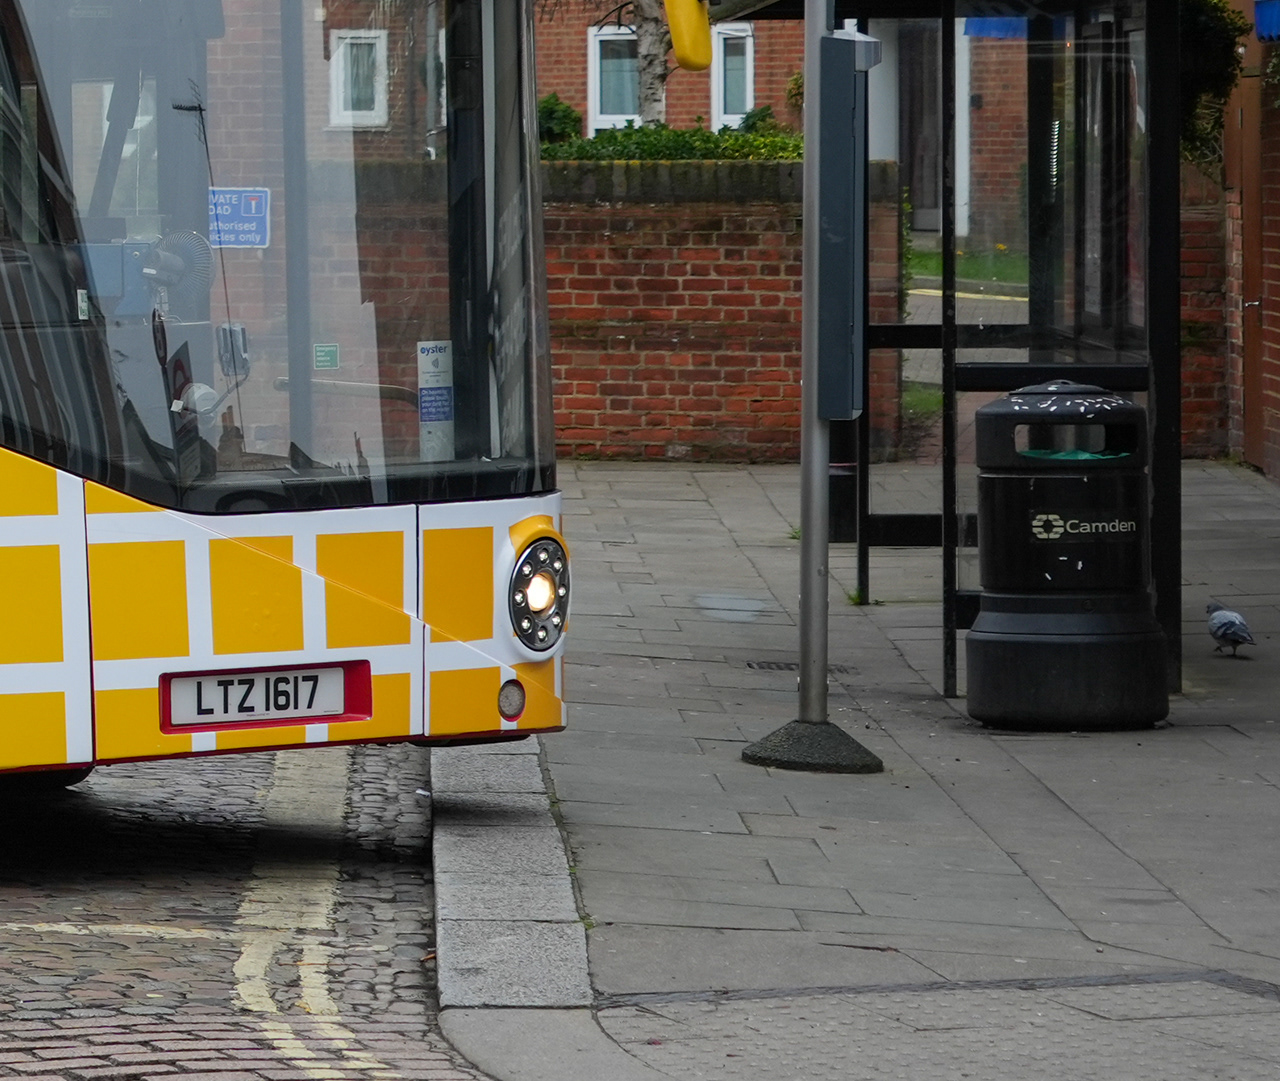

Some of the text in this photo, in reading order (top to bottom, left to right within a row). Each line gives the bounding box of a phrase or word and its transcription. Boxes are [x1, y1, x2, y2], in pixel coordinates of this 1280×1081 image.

[208, 205, 232, 215] OAD
[238, 232, 262, 244] only
[420, 345, 448, 358] oyster
[1066, 519, 1136, 533] Camden
[197, 674, 319, 715] LTZ 1617
